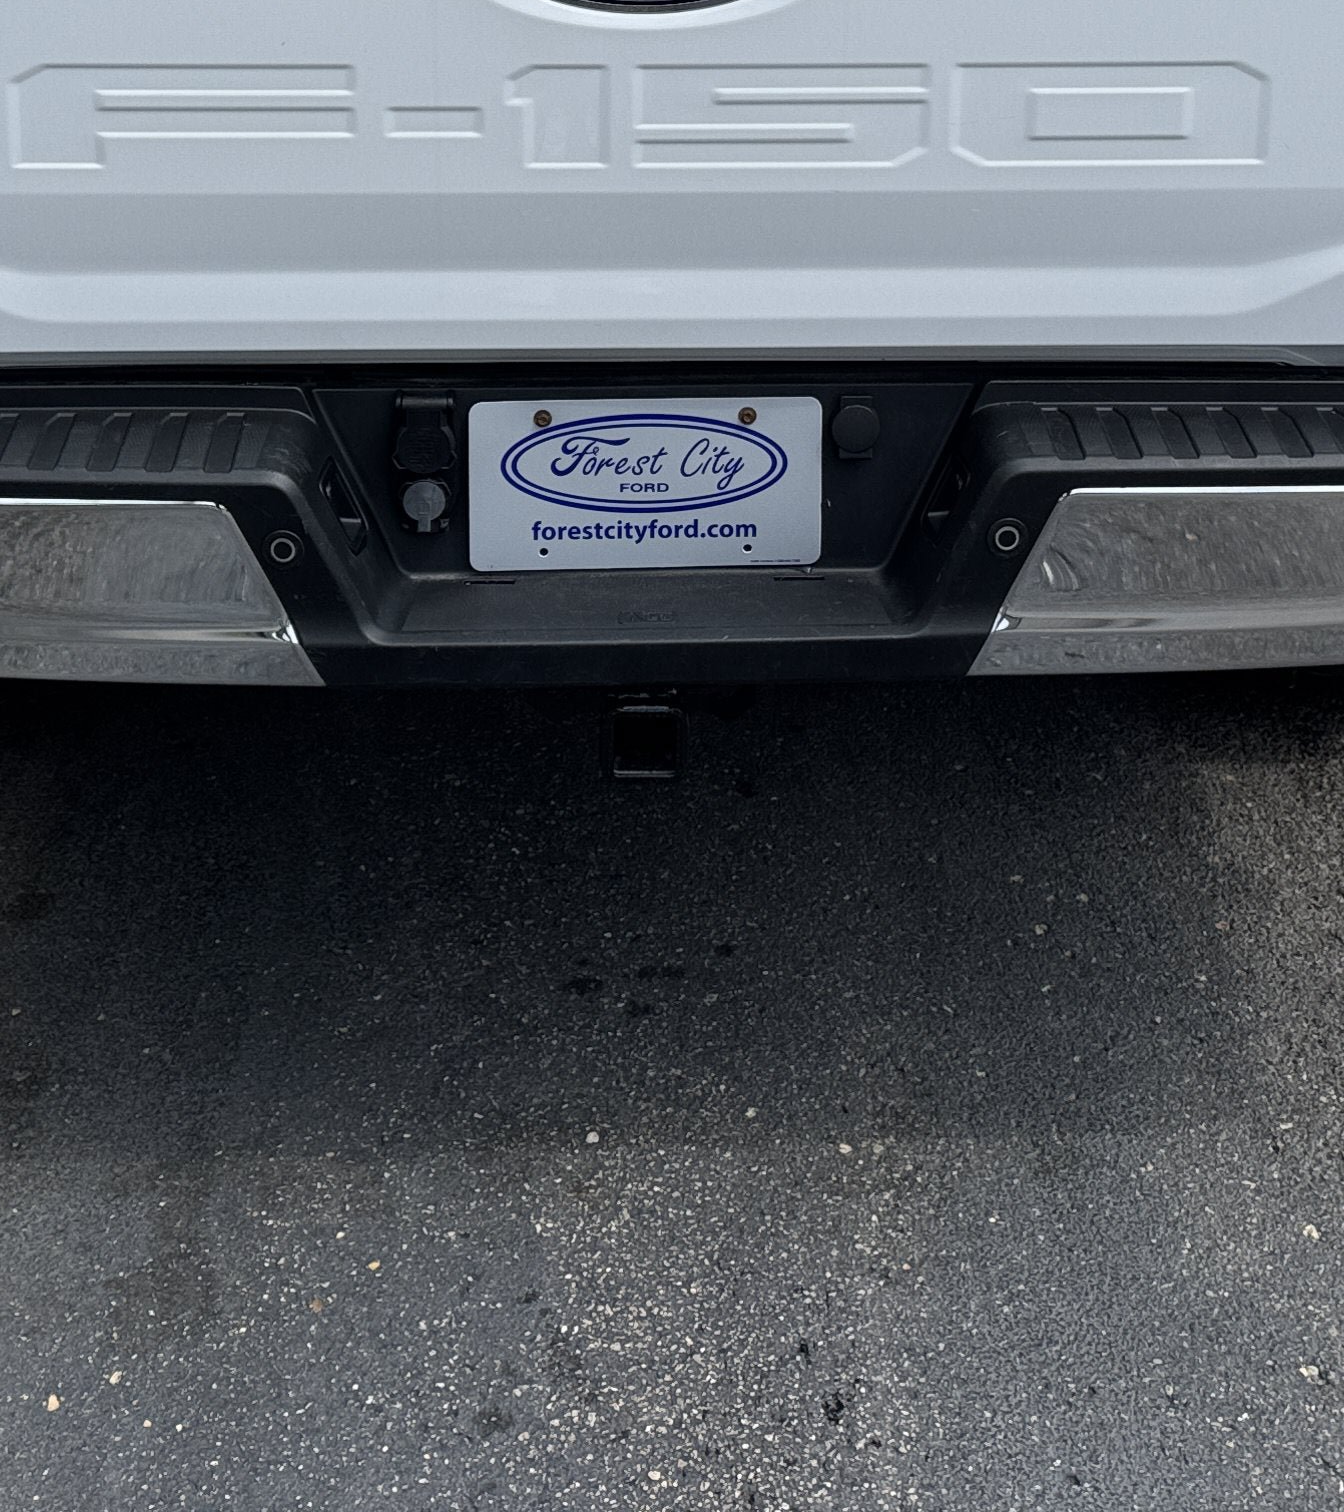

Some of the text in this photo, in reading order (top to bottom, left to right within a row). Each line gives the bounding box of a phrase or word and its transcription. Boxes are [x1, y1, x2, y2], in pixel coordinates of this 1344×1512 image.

[9, 63, 1271, 169] F-150
[550, 436, 745, 491] Forest City
[619, 482, 670, 493] FORD
[532, 519, 758, 544] forestcityford.com
